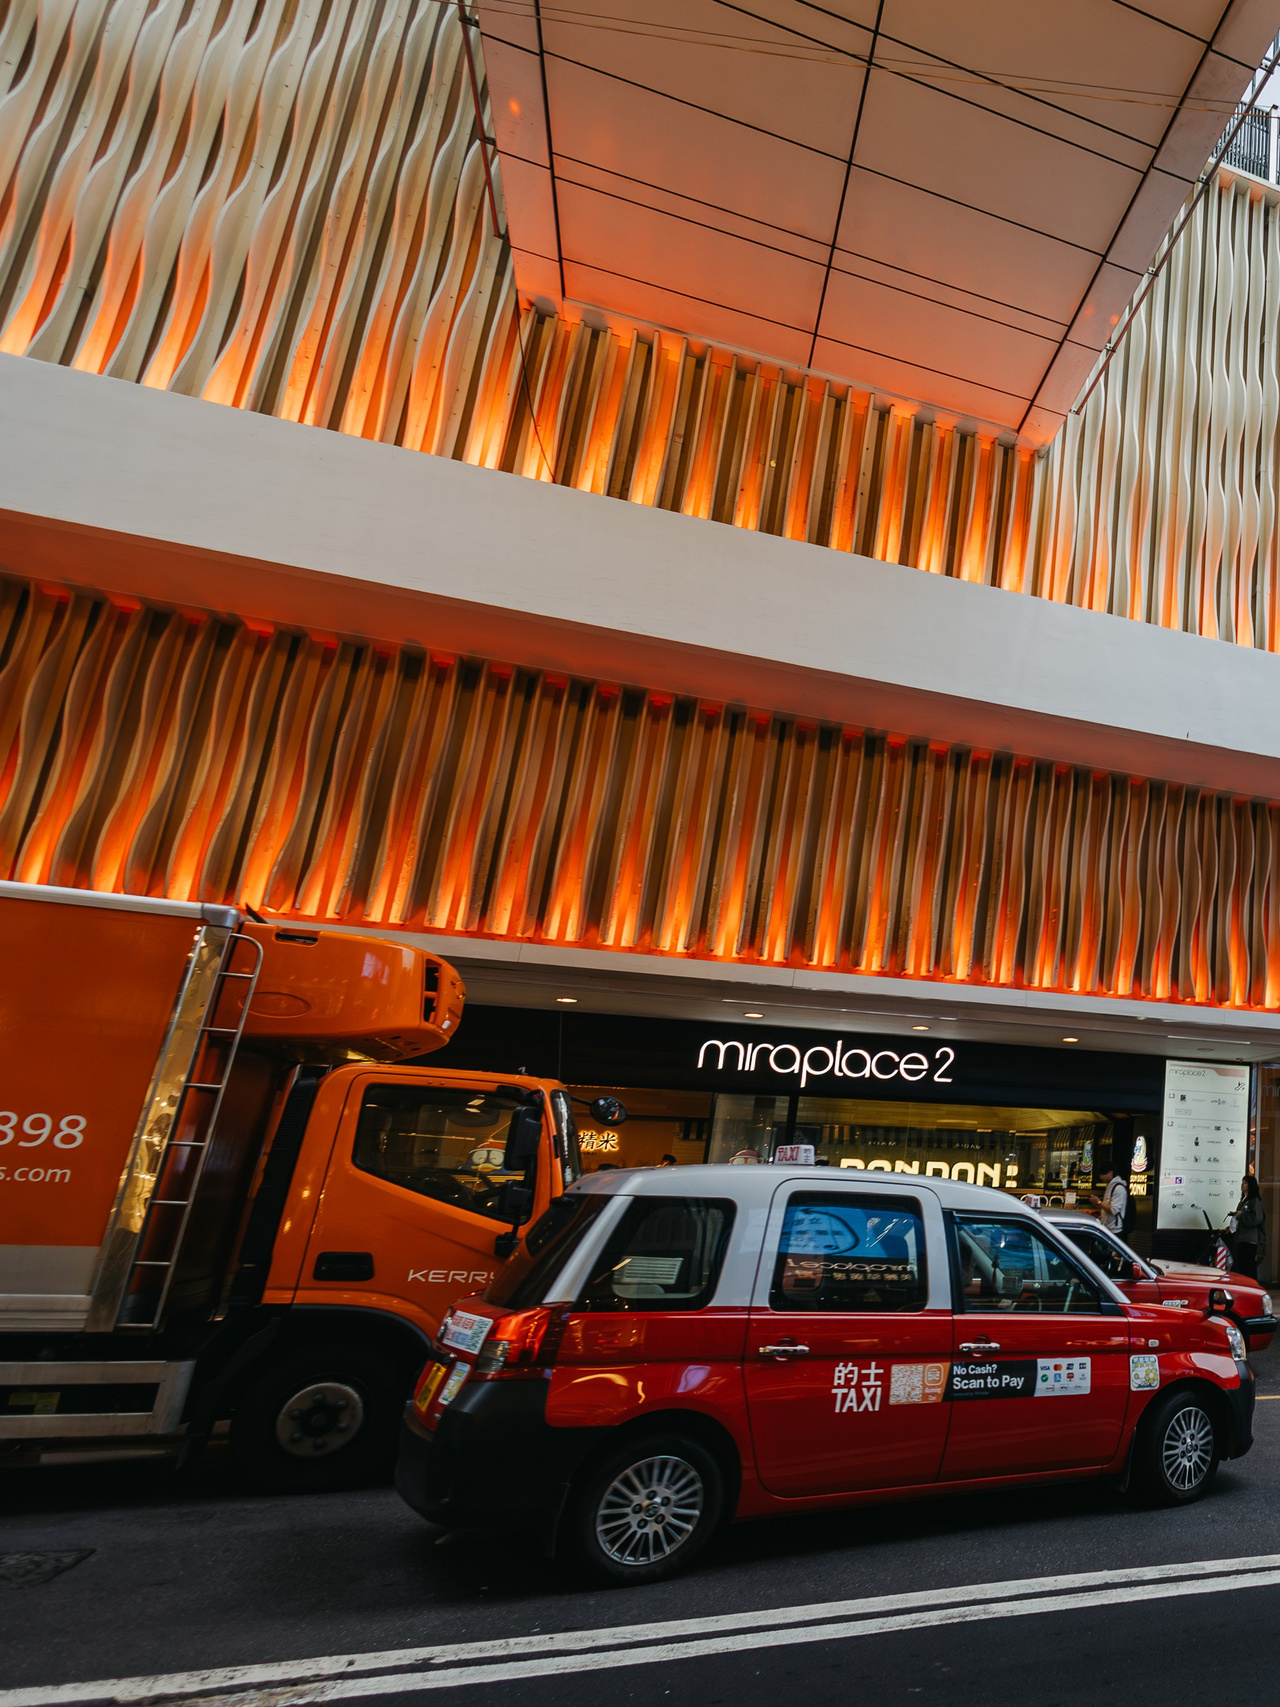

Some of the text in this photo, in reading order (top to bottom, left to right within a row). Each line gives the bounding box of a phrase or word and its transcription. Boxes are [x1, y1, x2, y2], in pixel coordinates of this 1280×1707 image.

[697, 1039, 955, 1088] miraplace 2
[578, 1130, 619, 1152] 精米
[777, 1146, 800, 1161] TAXI
[833, 1361, 884, 1386] 的士
[953, 1364, 998, 1375] No Cash?
[953, 1374, 1025, 1390] Scan to Pay
[831, 1387, 882, 1413] TAXI
